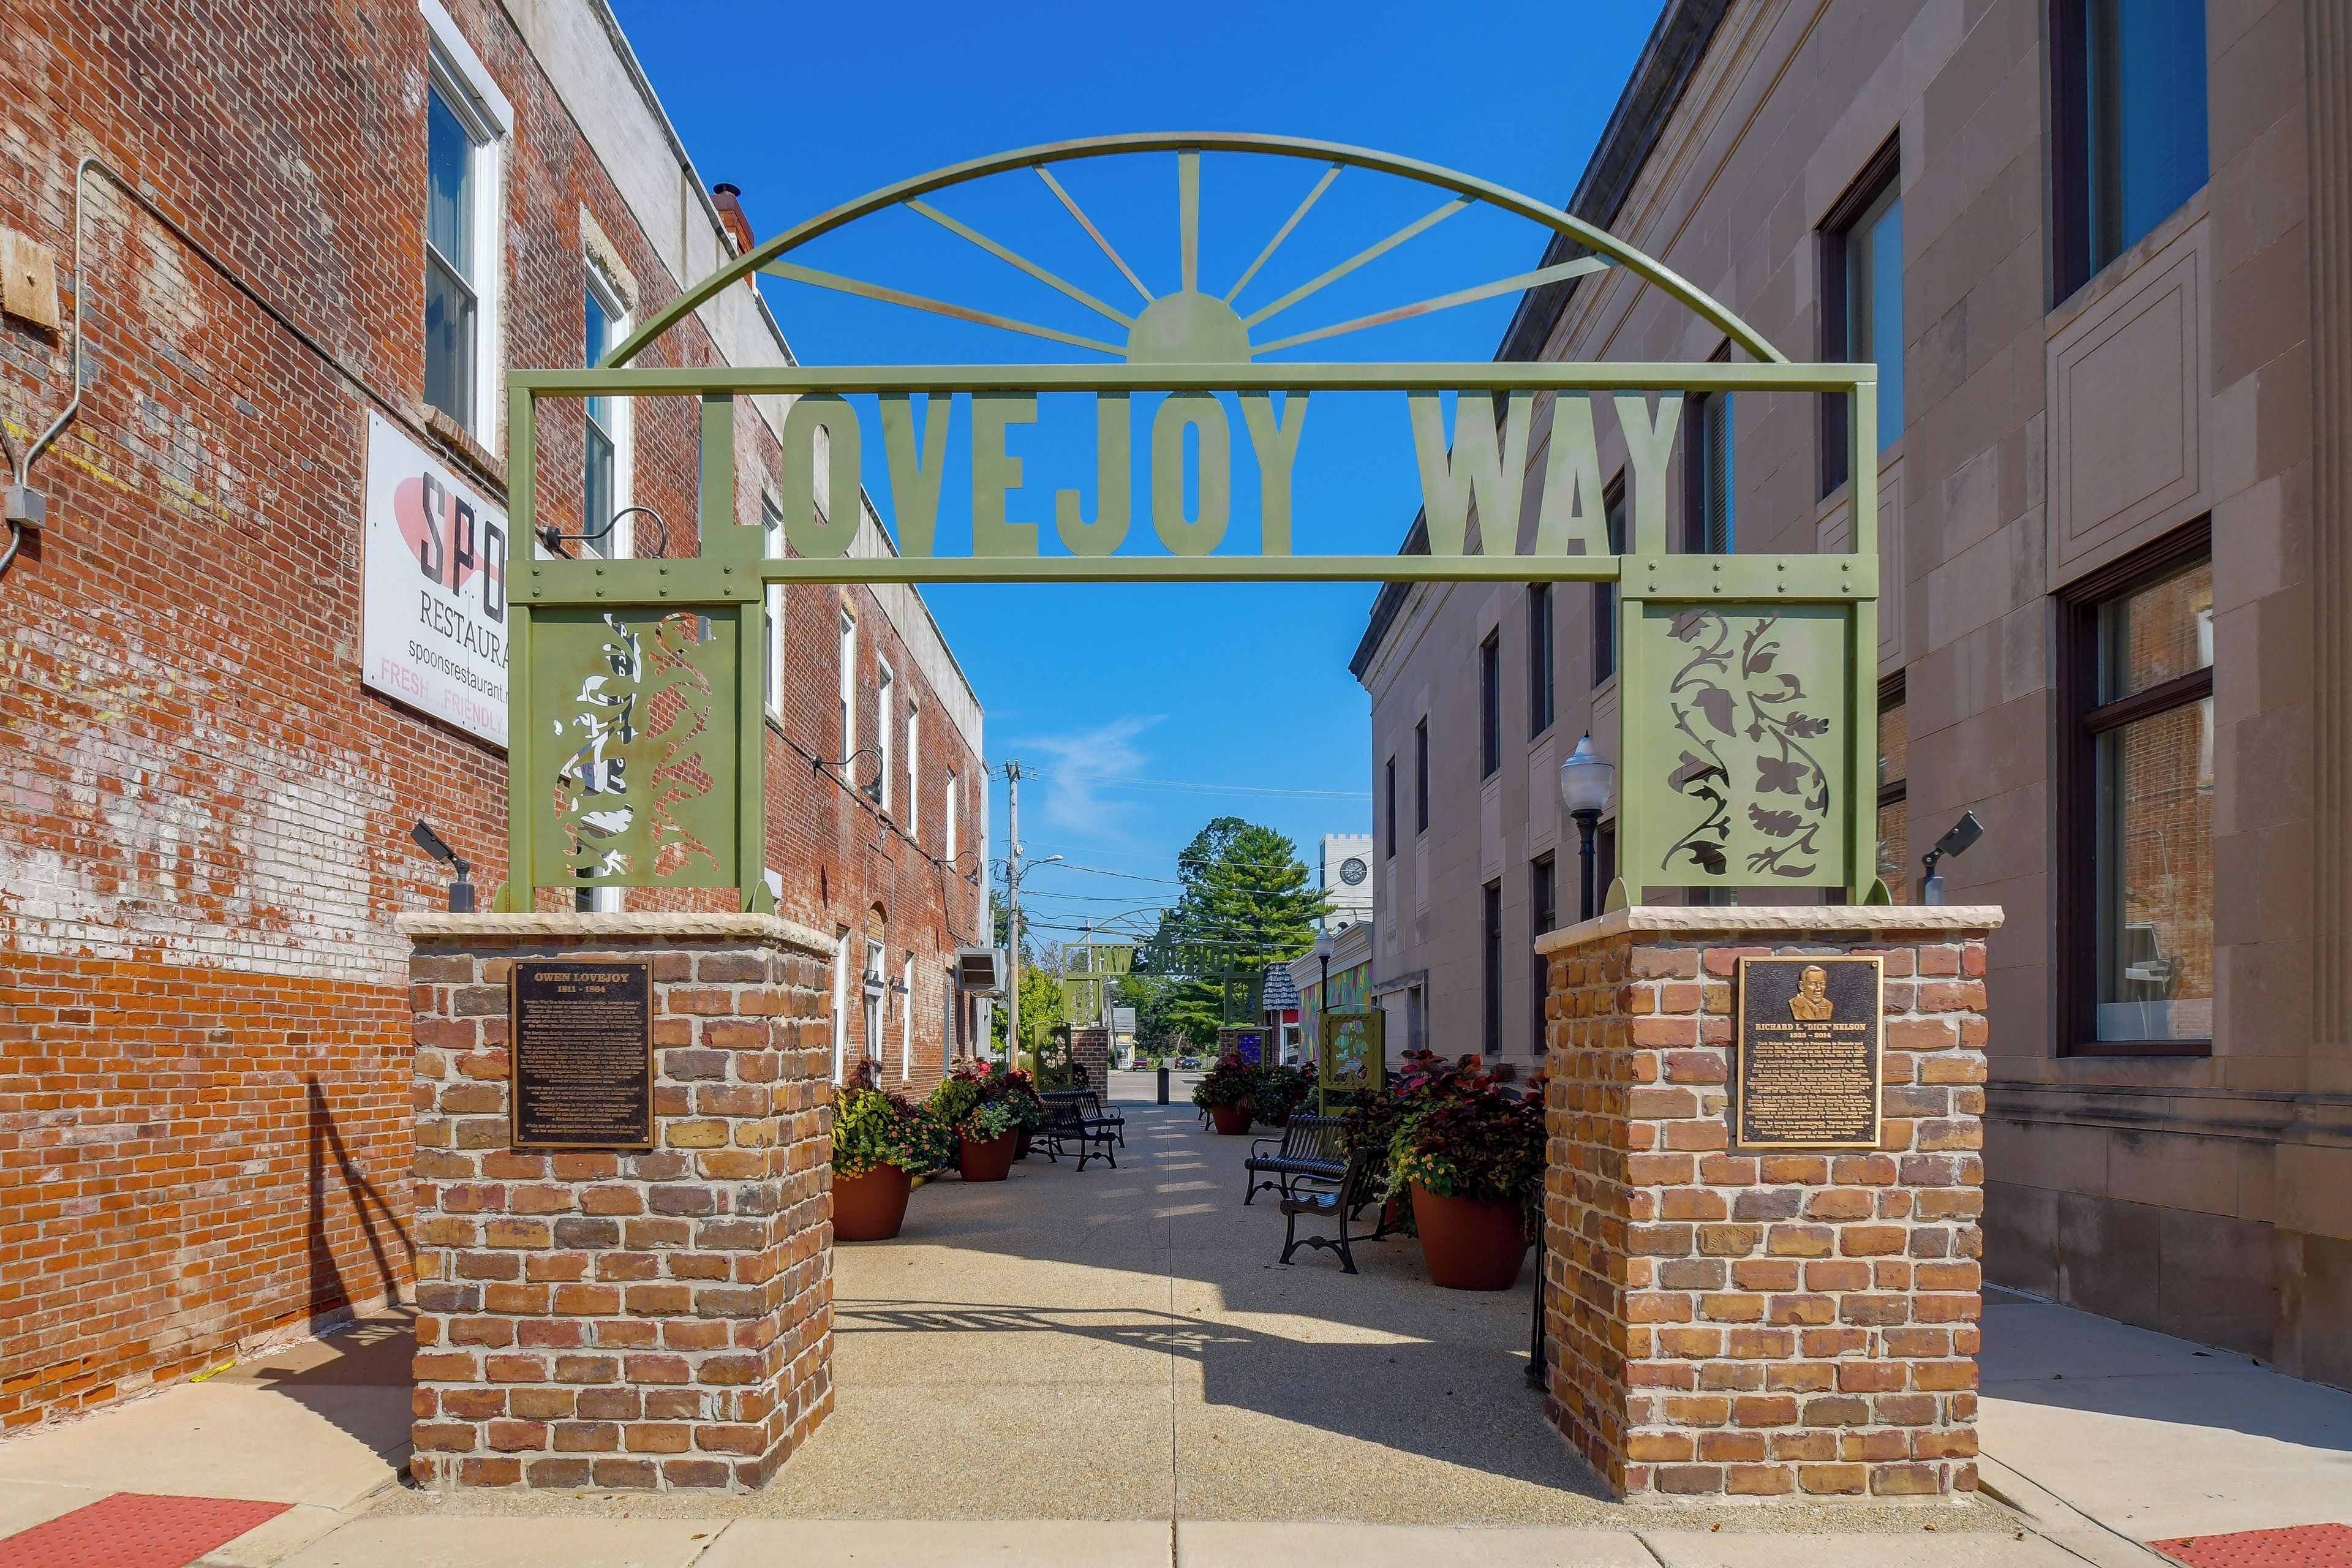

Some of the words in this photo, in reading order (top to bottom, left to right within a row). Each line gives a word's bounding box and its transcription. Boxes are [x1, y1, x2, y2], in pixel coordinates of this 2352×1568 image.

[702, 391, 1311, 558] LOVEJOY
[1406, 390, 1684, 556] WAY
[535, 973, 571, 982] OWEN
[573, 973, 630, 982] LOVEJOY
